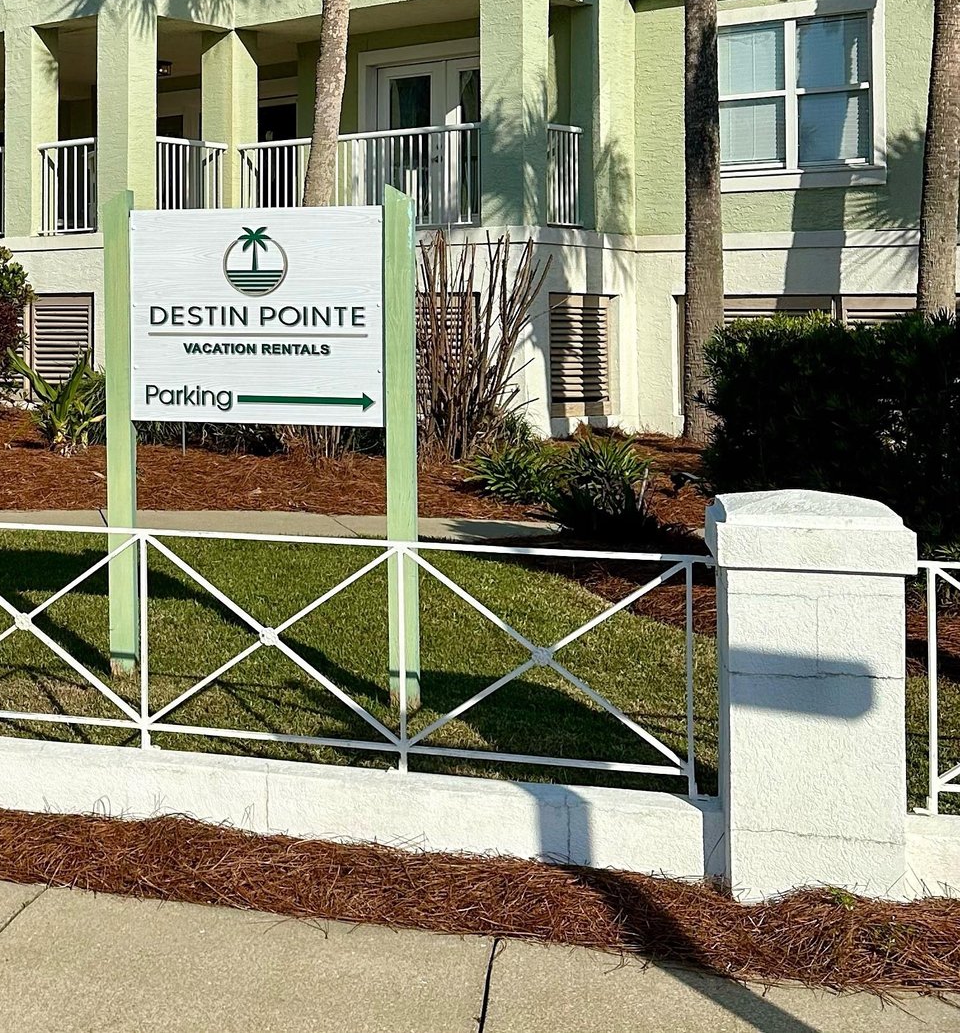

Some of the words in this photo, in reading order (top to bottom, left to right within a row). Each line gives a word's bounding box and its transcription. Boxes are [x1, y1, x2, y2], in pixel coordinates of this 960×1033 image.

[149, 305, 248, 327] DESTIN
[259, 306, 366, 328] POINTE
[183, 342, 257, 355] VACATION
[261, 343, 331, 356] RENTALS
[145, 384, 233, 411] Parking
